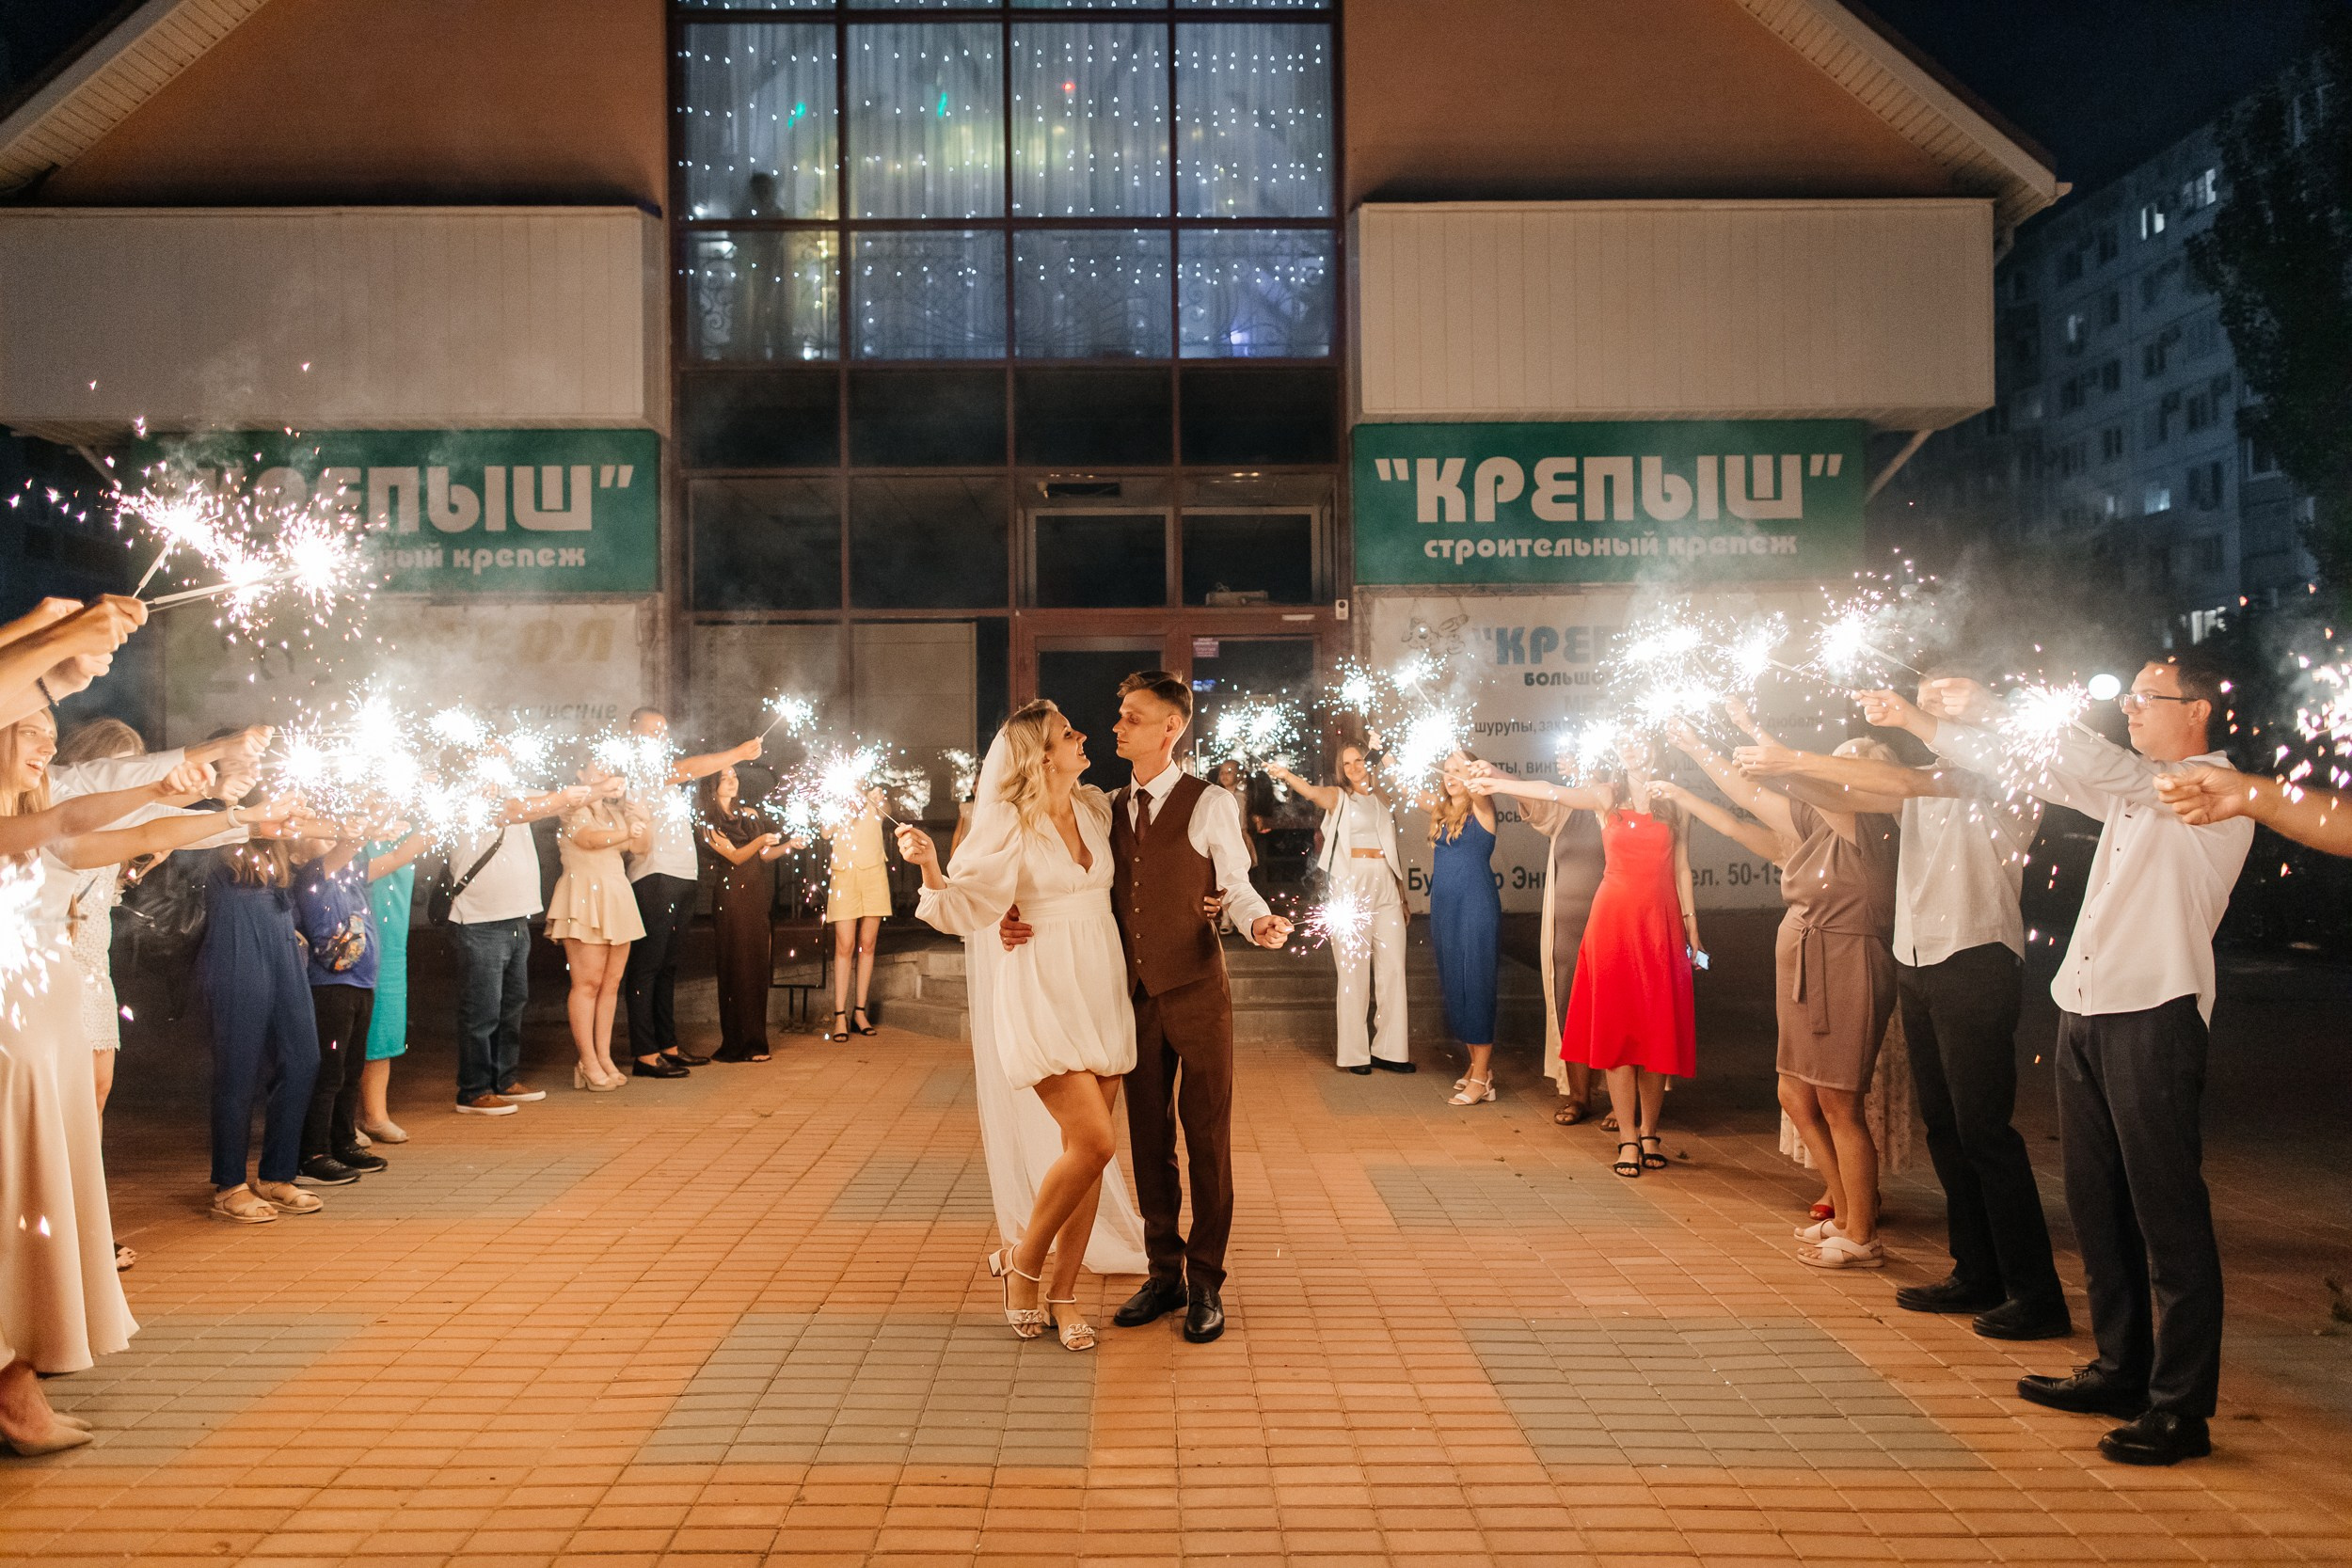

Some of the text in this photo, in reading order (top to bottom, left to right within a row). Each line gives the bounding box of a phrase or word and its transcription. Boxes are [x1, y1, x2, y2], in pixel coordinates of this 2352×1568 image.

[1375, 453, 1844, 524] "КРЕПЫШ"
[453, 547, 587, 576] крепеж
[1423, 531, 1799, 564] строительный крепеж
[1474, 721, 1537, 737] шурупы,
[1691, 862, 1784, 886] ел. 50-15
